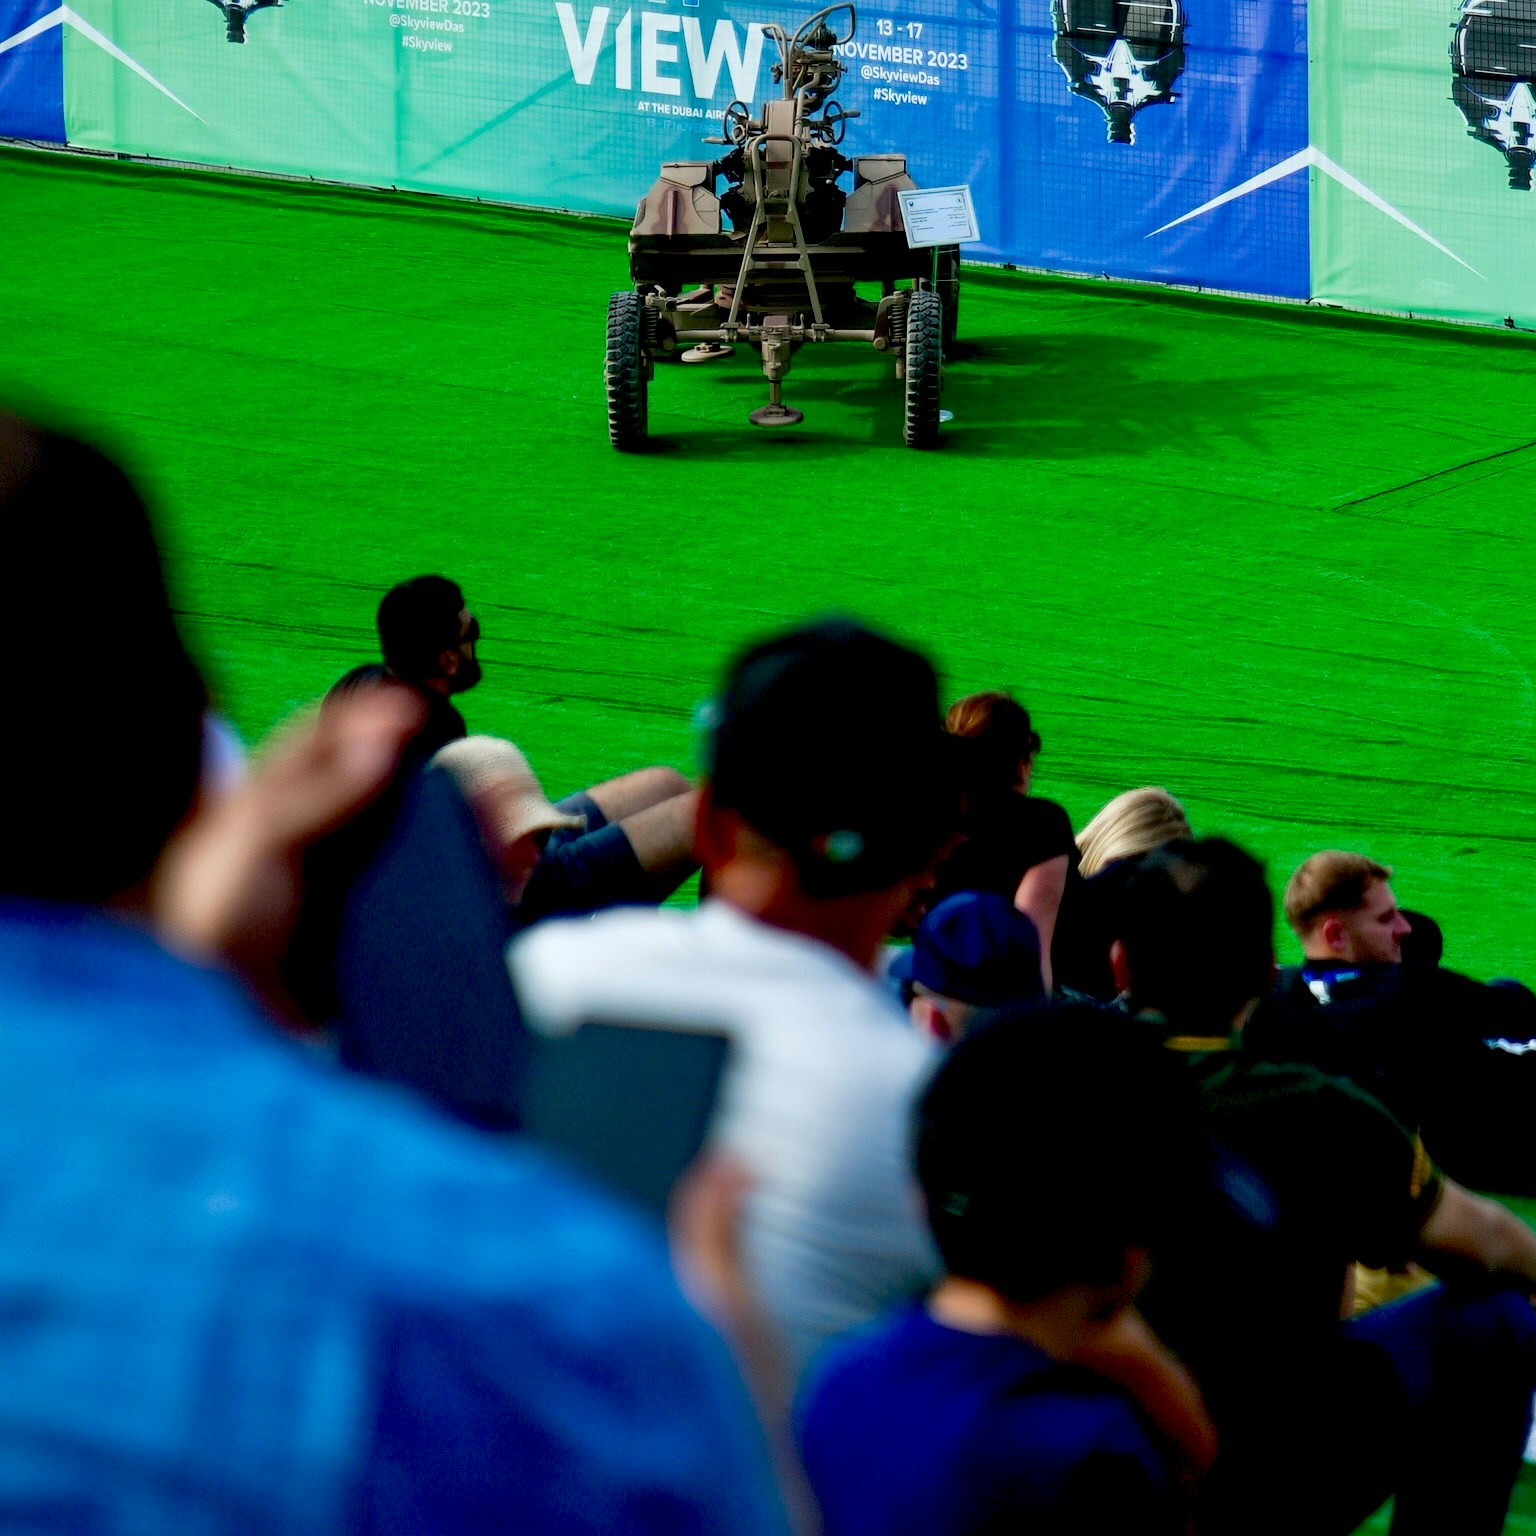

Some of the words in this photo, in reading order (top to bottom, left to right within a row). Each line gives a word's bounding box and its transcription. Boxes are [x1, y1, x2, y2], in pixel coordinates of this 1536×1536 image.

[452, 0, 490, 18] 2023
[389, 14, 464, 33] @SkyviewDas
[876, 18, 893, 37] 13
[906, 21, 923, 39] 17
[402, 35, 453, 52] #Skyview
[555, 2, 767, 103] VIEW
[833, 41, 923, 66] NOVEMBER
[927, 50, 968, 70] 2023
[860, 65, 940, 86] @SkyviewDas
[873, 88, 928, 105] #Skyview
[638, 101, 651, 112] AT
[652, 102, 670, 114] THE
[672, 105, 703, 118] DUBAI
